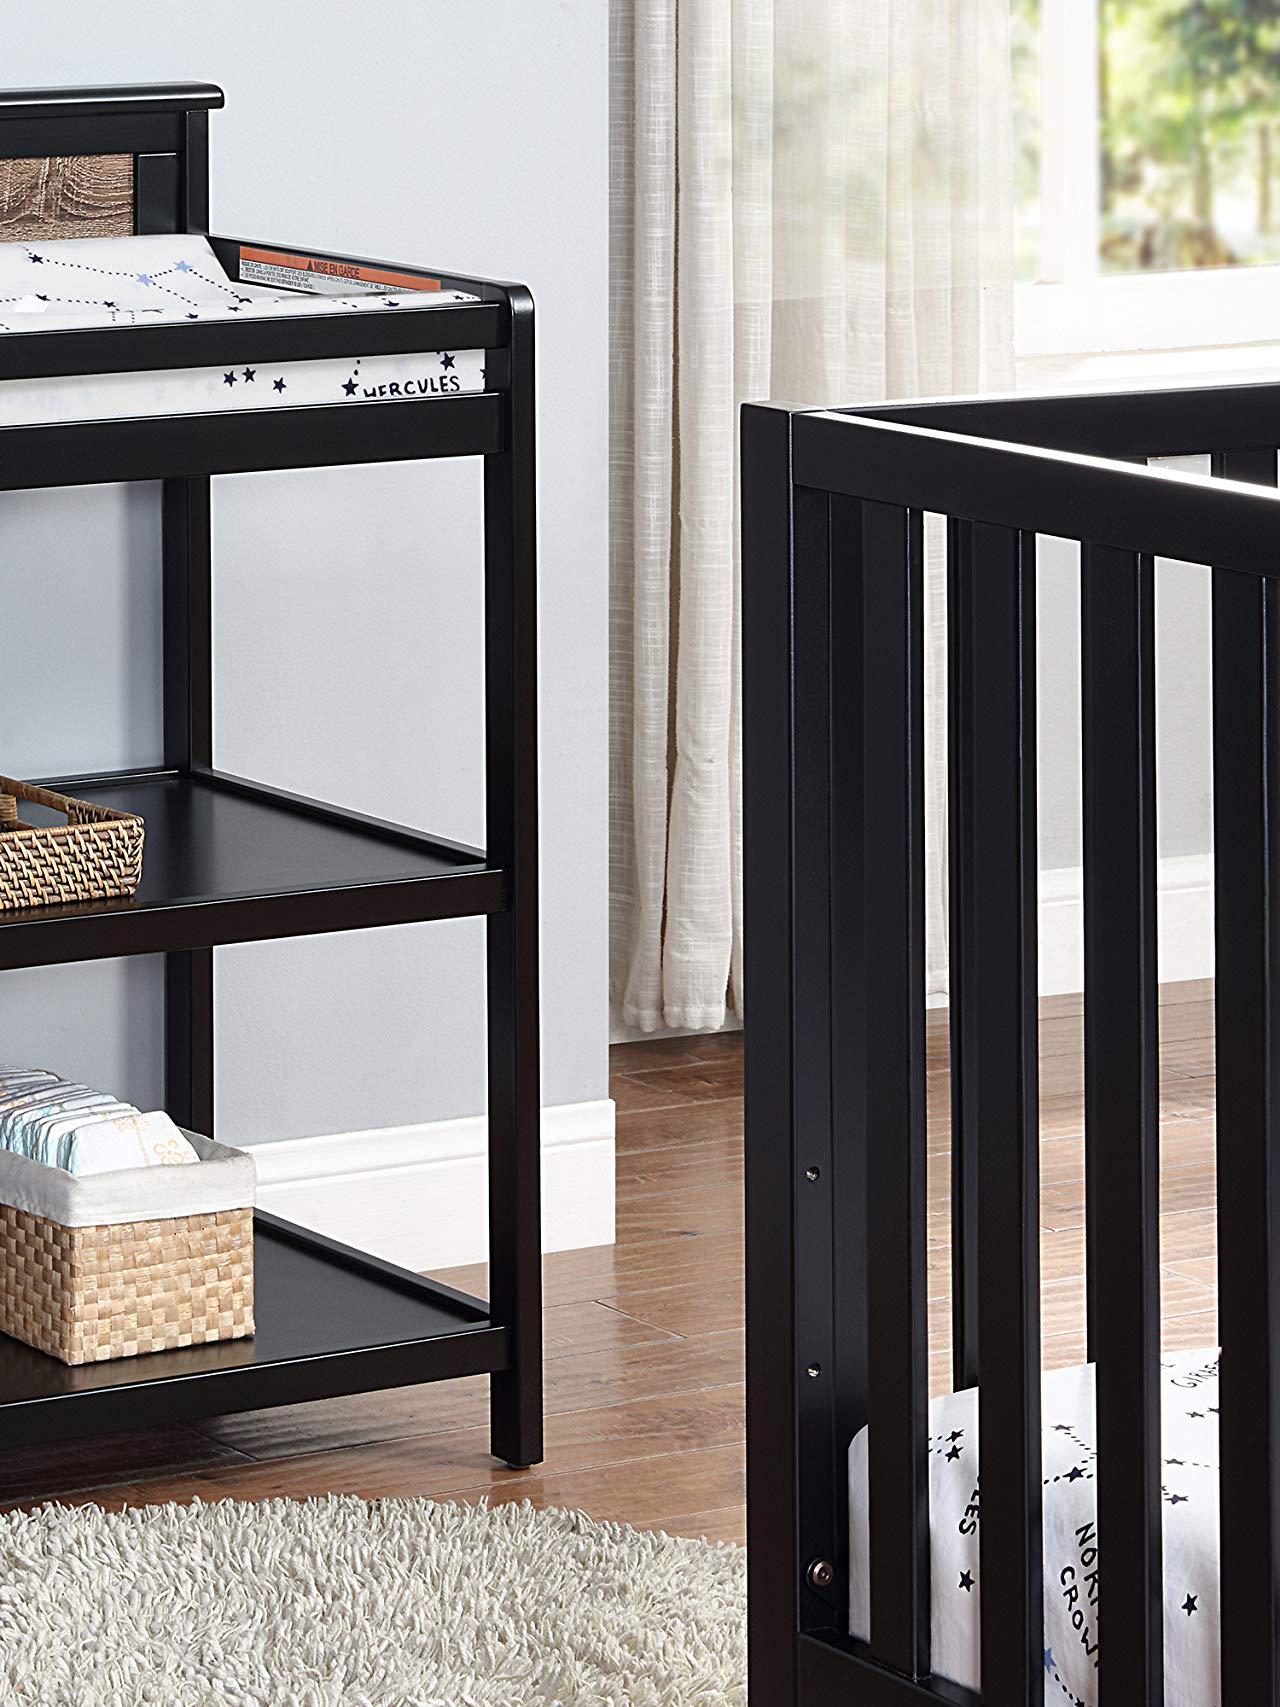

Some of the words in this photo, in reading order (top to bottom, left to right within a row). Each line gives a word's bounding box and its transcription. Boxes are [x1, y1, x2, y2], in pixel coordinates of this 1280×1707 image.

[314, 260, 328, 273] MISE
[329, 263, 339, 275] EN
[340, 265, 360, 280] GARDE
[1060, 1565, 1099, 1669] CROW
